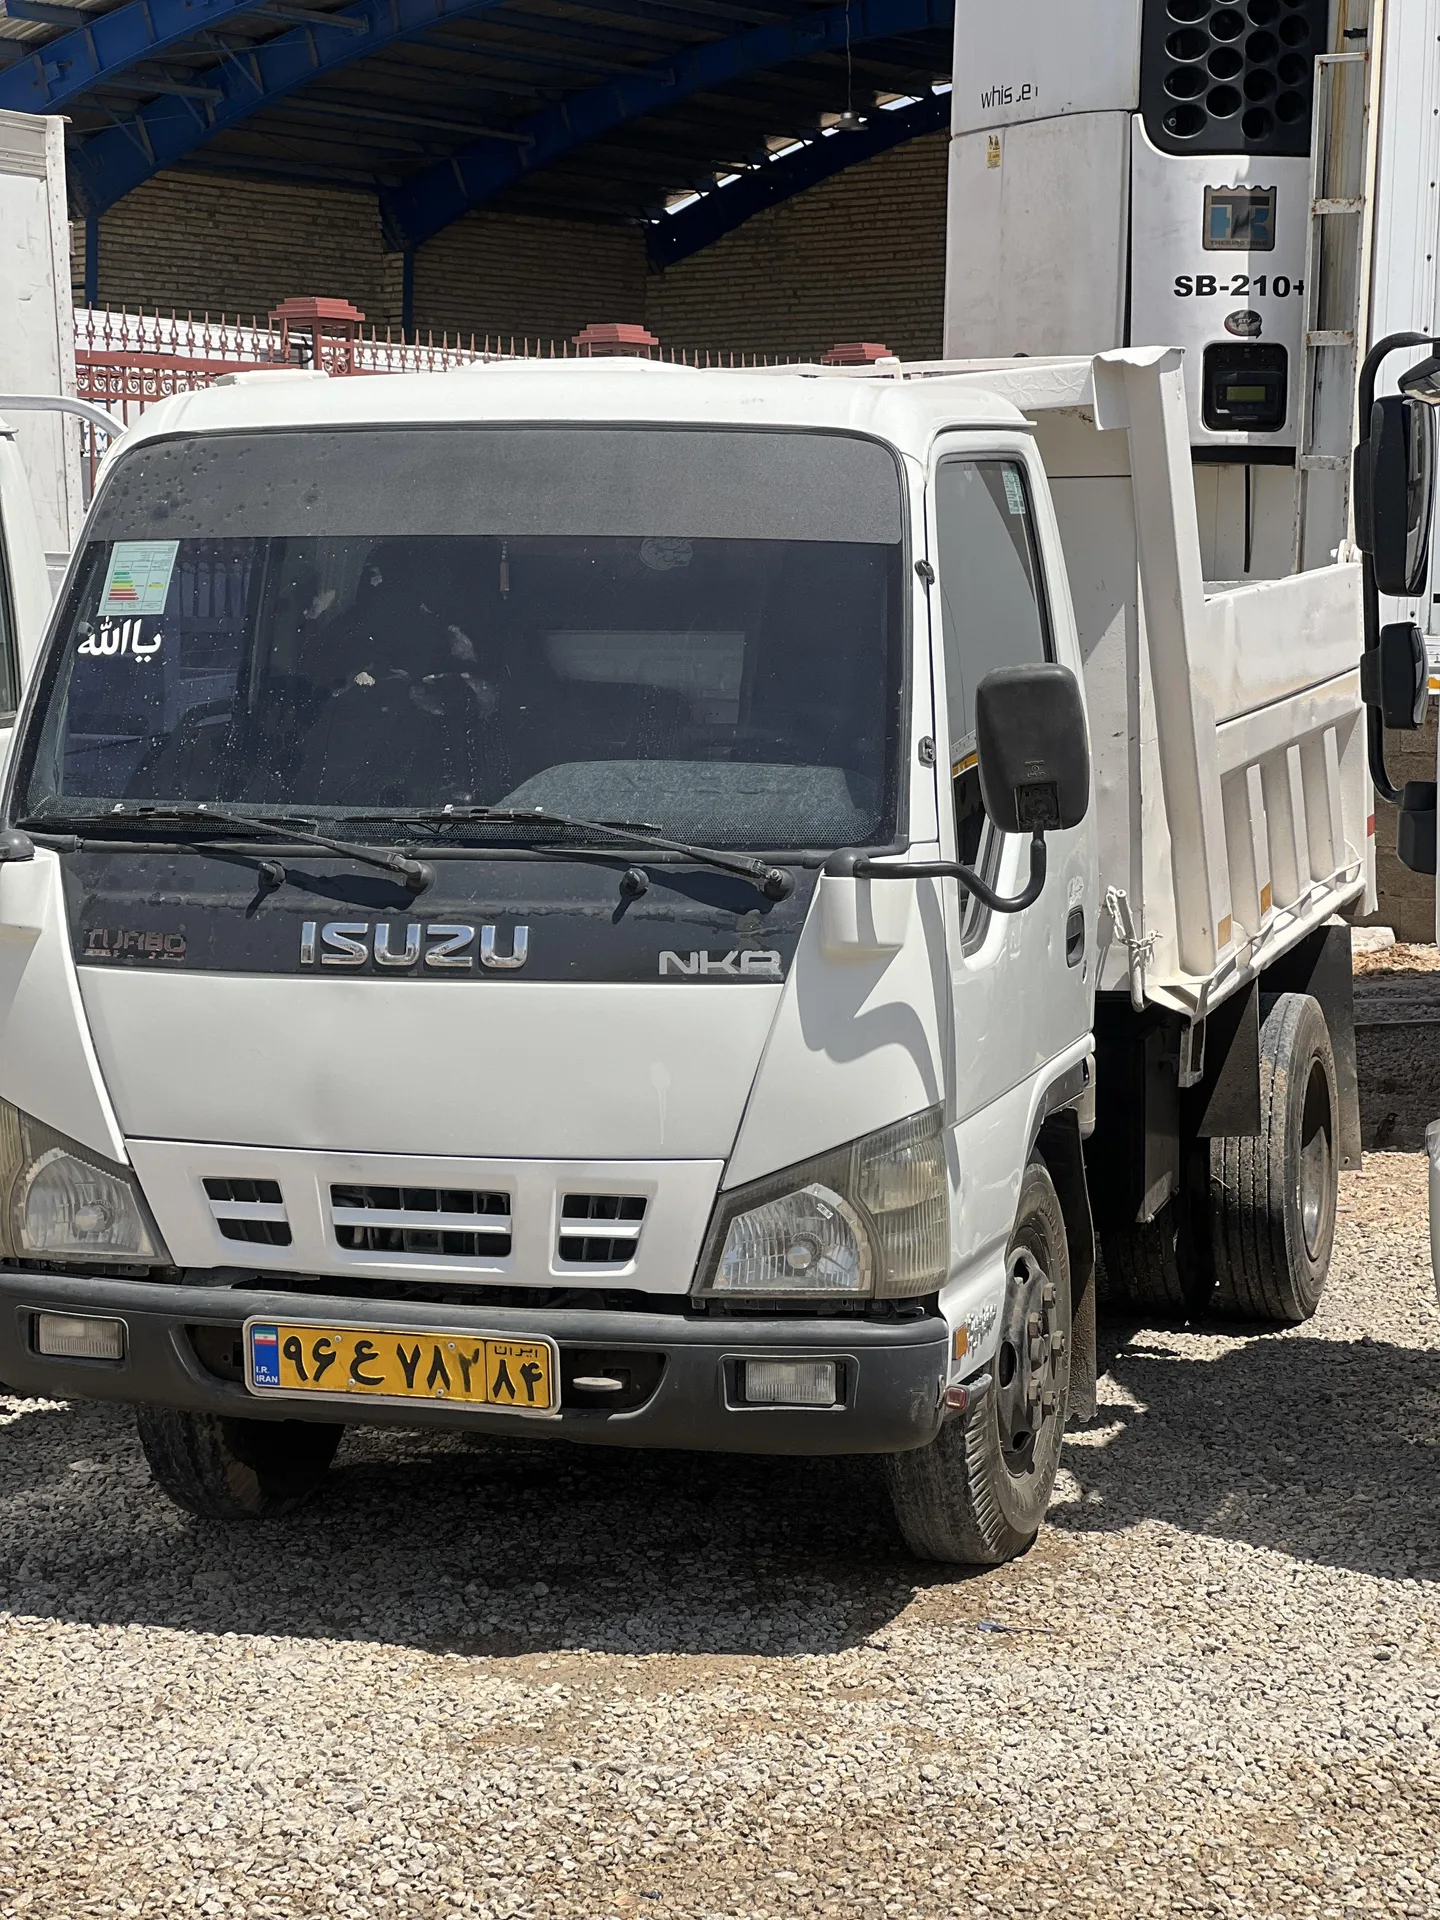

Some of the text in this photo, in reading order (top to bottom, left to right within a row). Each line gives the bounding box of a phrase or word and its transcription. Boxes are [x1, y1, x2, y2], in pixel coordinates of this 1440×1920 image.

[1173, 274, 1305, 298] SB-210+
[300, 921, 529, 969] ISUZU
[658, 950, 783, 976] NKR
[255, 1365, 270, 1374] I.R.
[256, 1374, 278, 1383] IRAN
